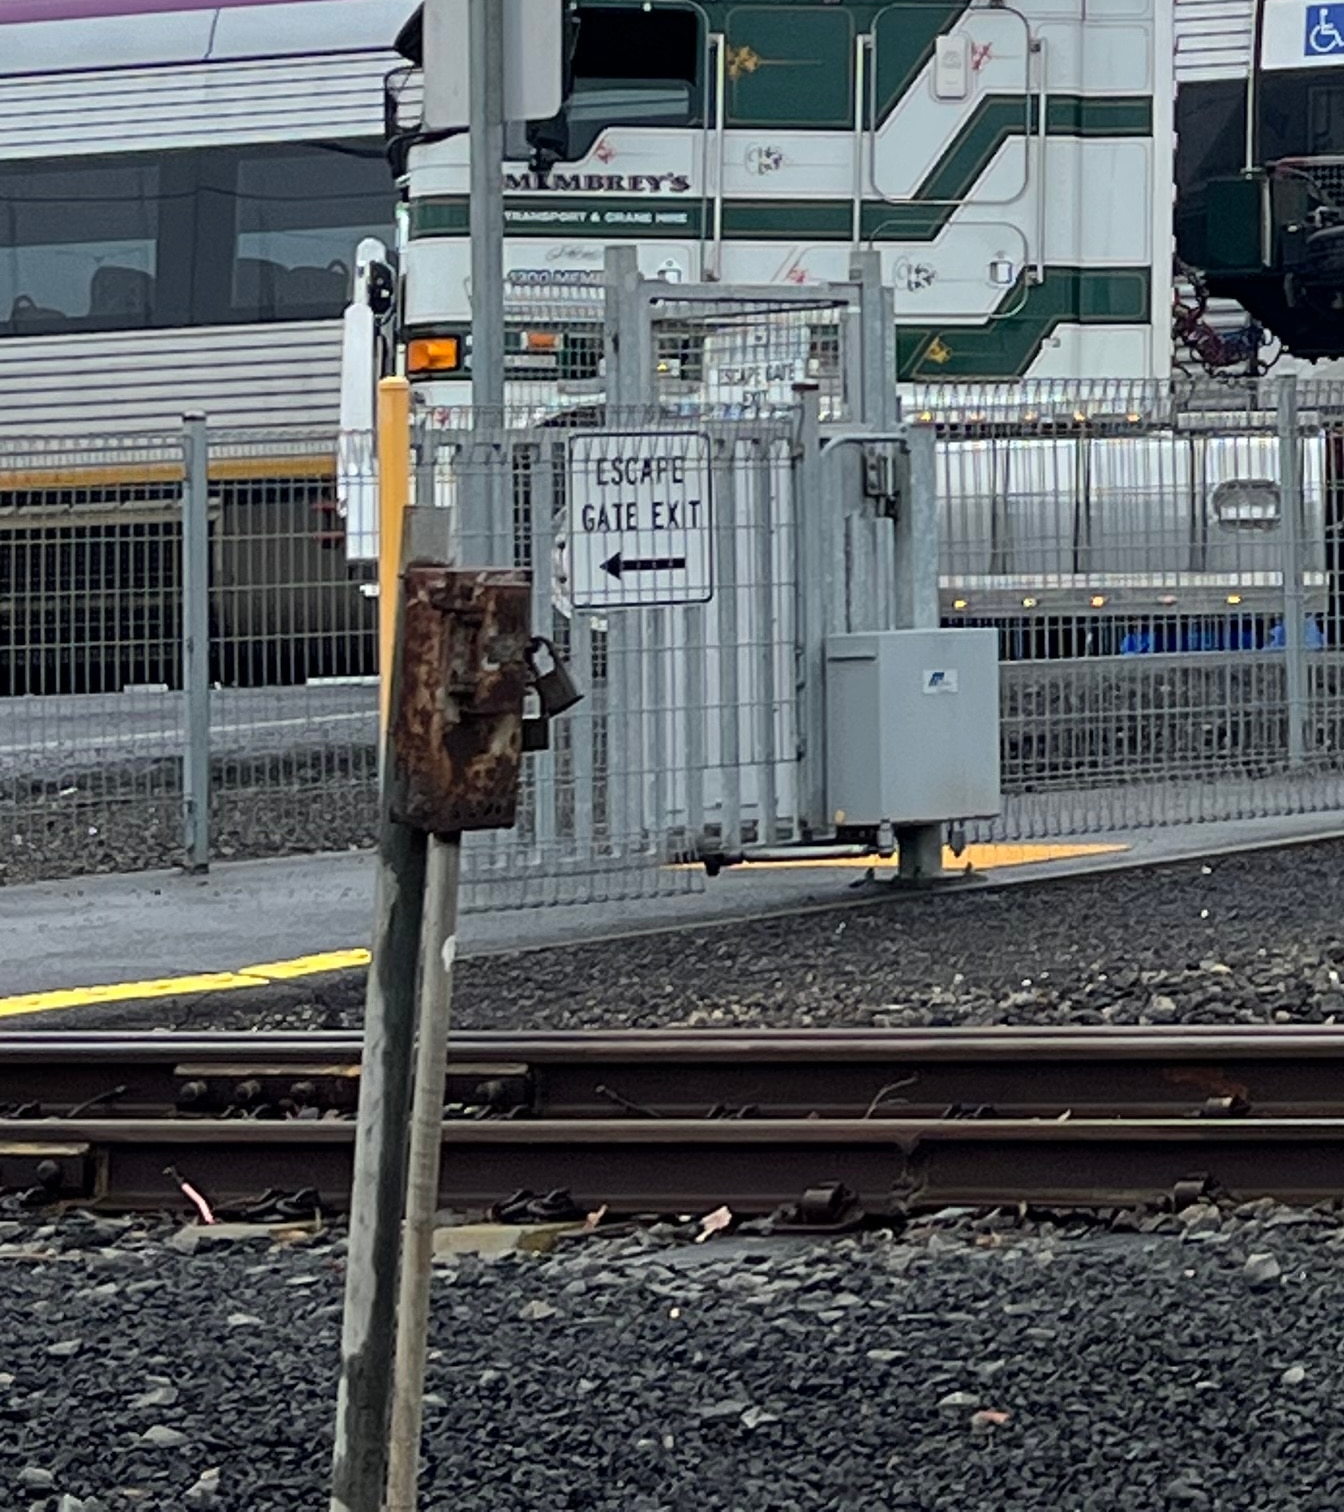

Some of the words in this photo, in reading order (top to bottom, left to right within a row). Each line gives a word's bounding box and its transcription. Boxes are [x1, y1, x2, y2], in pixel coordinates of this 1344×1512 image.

[597, 457, 684, 485] ESCAPE
[582, 502, 637, 531] GATE
[652, 500, 700, 529] EXIT
